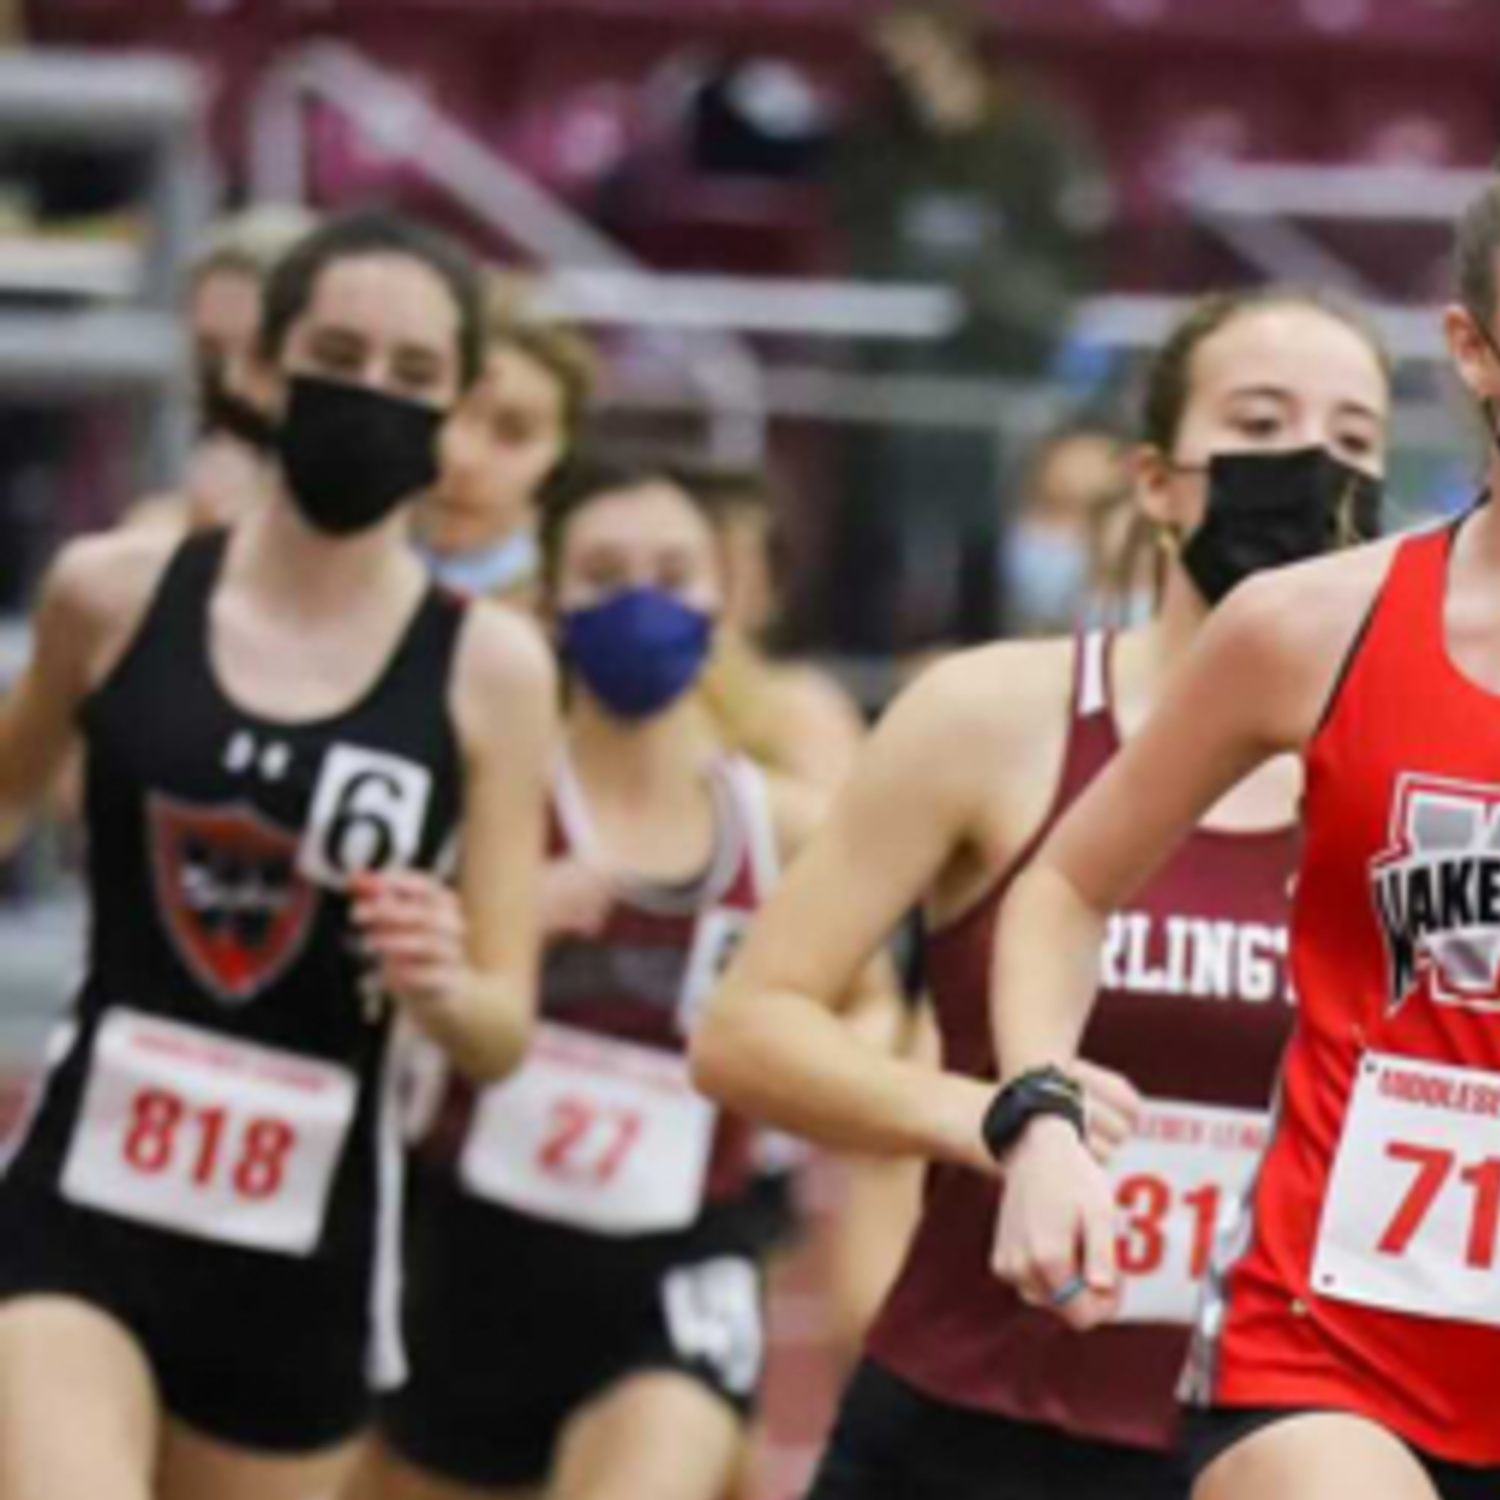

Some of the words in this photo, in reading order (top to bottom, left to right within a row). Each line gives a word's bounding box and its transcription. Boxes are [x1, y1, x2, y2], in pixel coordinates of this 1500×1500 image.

[322, 771, 405, 882] 6
[122, 1083, 299, 1205] 818
[534, 1093, 645, 1188] 27
[1113, 1173, 1222, 1280] 31
